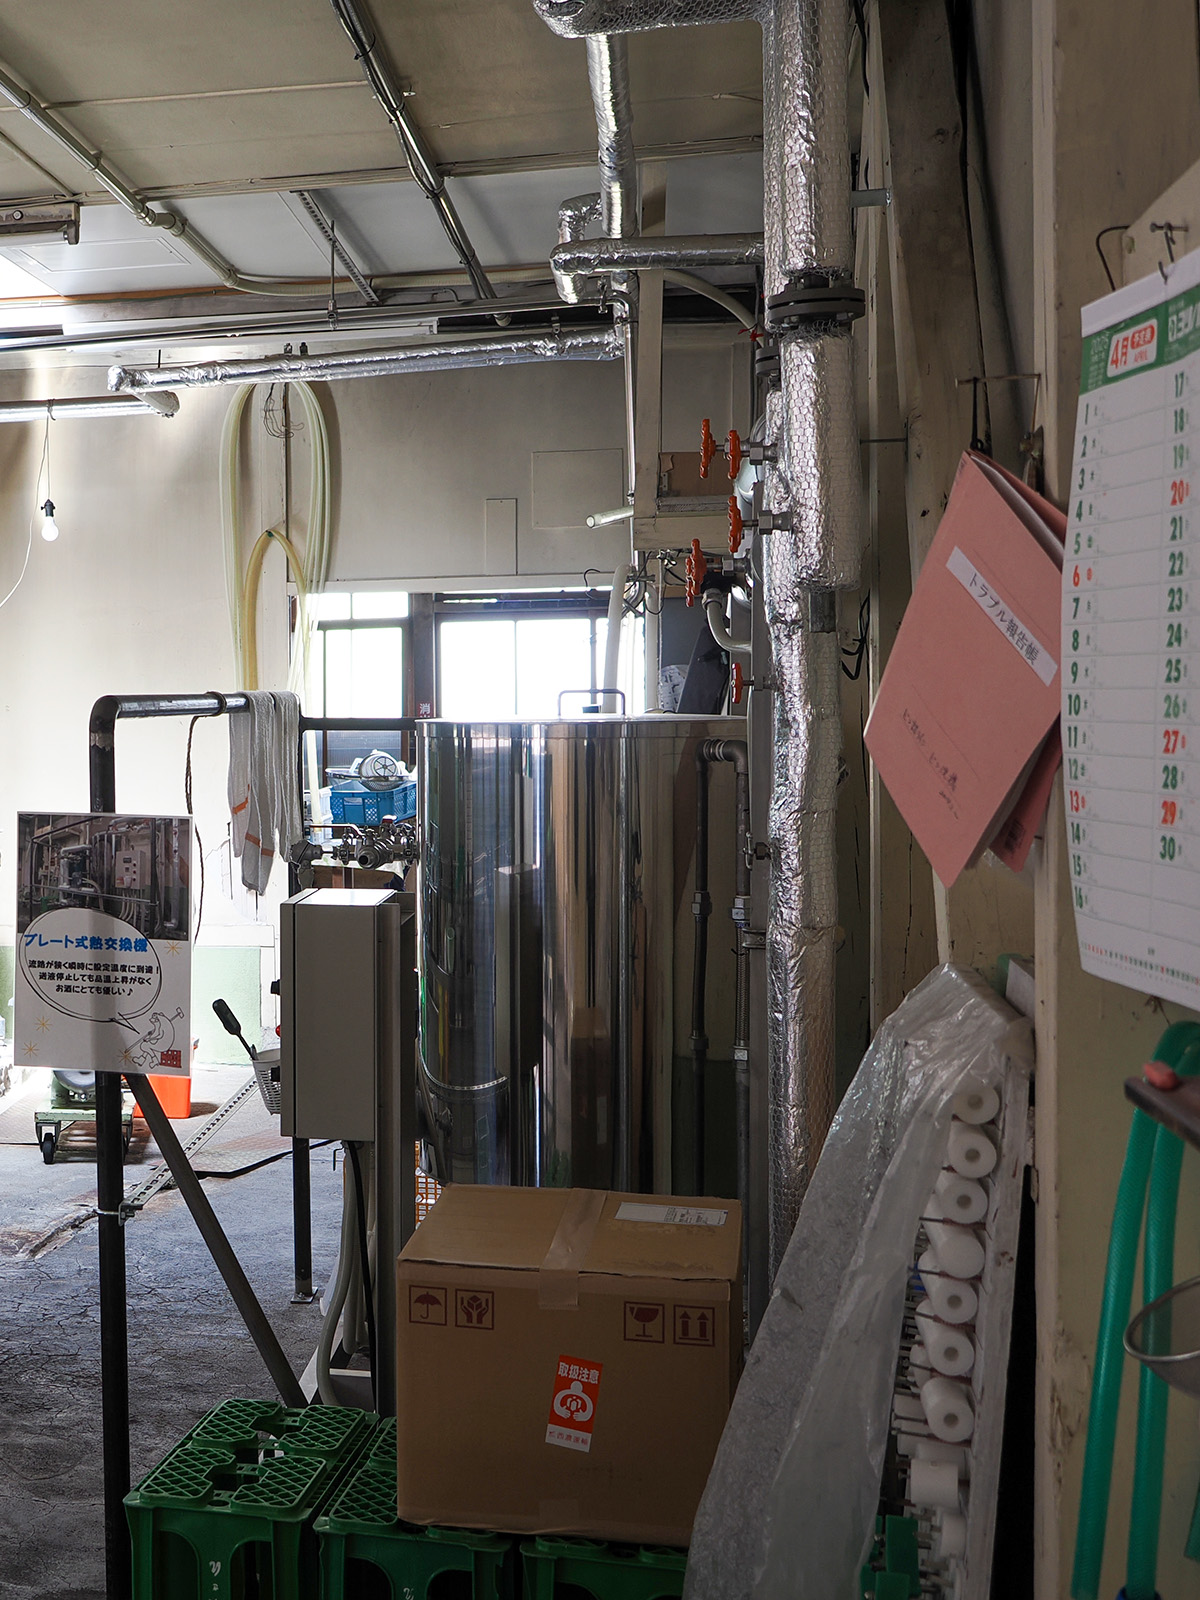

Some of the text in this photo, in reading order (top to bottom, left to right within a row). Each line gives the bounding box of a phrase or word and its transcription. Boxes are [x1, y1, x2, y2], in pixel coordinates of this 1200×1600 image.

[1110, 336, 1130, 369] 4月
[1175, 372, 1184, 397] 17
[1085, 404, 1089, 424] 1
[1174, 408, 1184, 433] 18
[1081, 436, 1087, 457] 2
[1174, 444, 1184, 469] 19
[1079, 468, 1085, 490] 3
[1171, 480, 1184, 505] 20
[1076, 501, 1082, 521] 4
[1171, 516, 1182, 541] 21
[1074, 533, 1080, 554] 5
[1169, 552, 1183, 576] 22
[1073, 566, 1080, 587] 6
[1073, 597, 1080, 619] 7
[1168, 588, 1182, 612] 23
[968, 572, 1039, 666] トラブル報告帳
[1072, 630, 1079, 651] 8
[1167, 623, 1181, 647] 24
[1071, 662, 1078, 683] 9
[1165, 659, 1181, 683] 25
[1068, 694, 1080, 716] 10
[1164, 695, 1180, 718] 26
[1068, 726, 1077, 747] 11
[1163, 730, 1179, 754] 27
[1069, 758, 1078, 780] 12
[1163, 765, 1177, 790] 28
[1070, 790, 1079, 812] 13
[1162, 801, 1176, 825] 29
[1071, 822, 1080, 844] 14
[1160, 836, 1175, 860] 30
[1073, 855, 1081, 876] 15
[558, 1362, 600, 1384] 取扱注意
